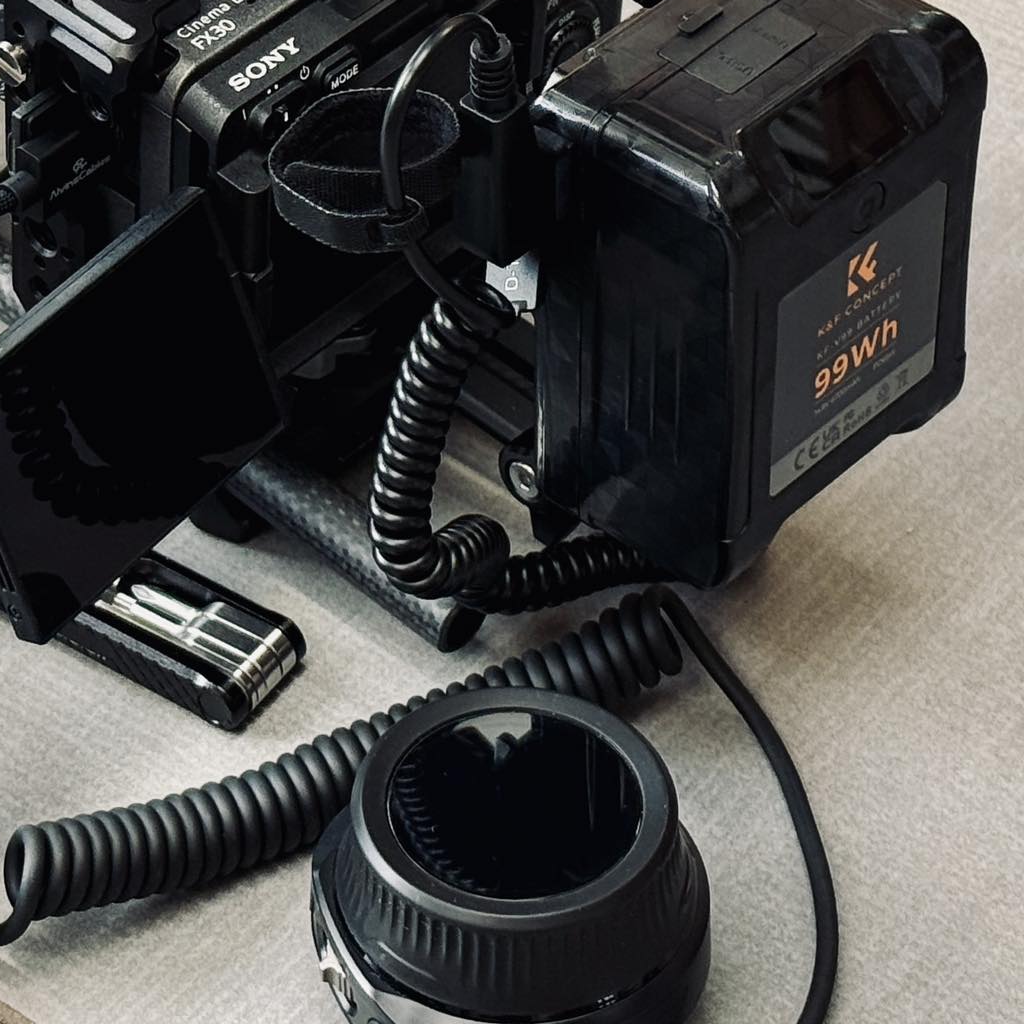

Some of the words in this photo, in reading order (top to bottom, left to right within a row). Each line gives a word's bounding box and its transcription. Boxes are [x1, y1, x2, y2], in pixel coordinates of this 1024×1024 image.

[176, 3, 231, 39] Cinema
[190, 19, 237, 51] FX30
[228, 36, 301, 92] SONY
[330, 64, 359, 91] MODE
[817, 313, 841, 337] K&F
[844, 266, 904, 316] CONCEPT
[814, 317, 898, 399] 99Wh
